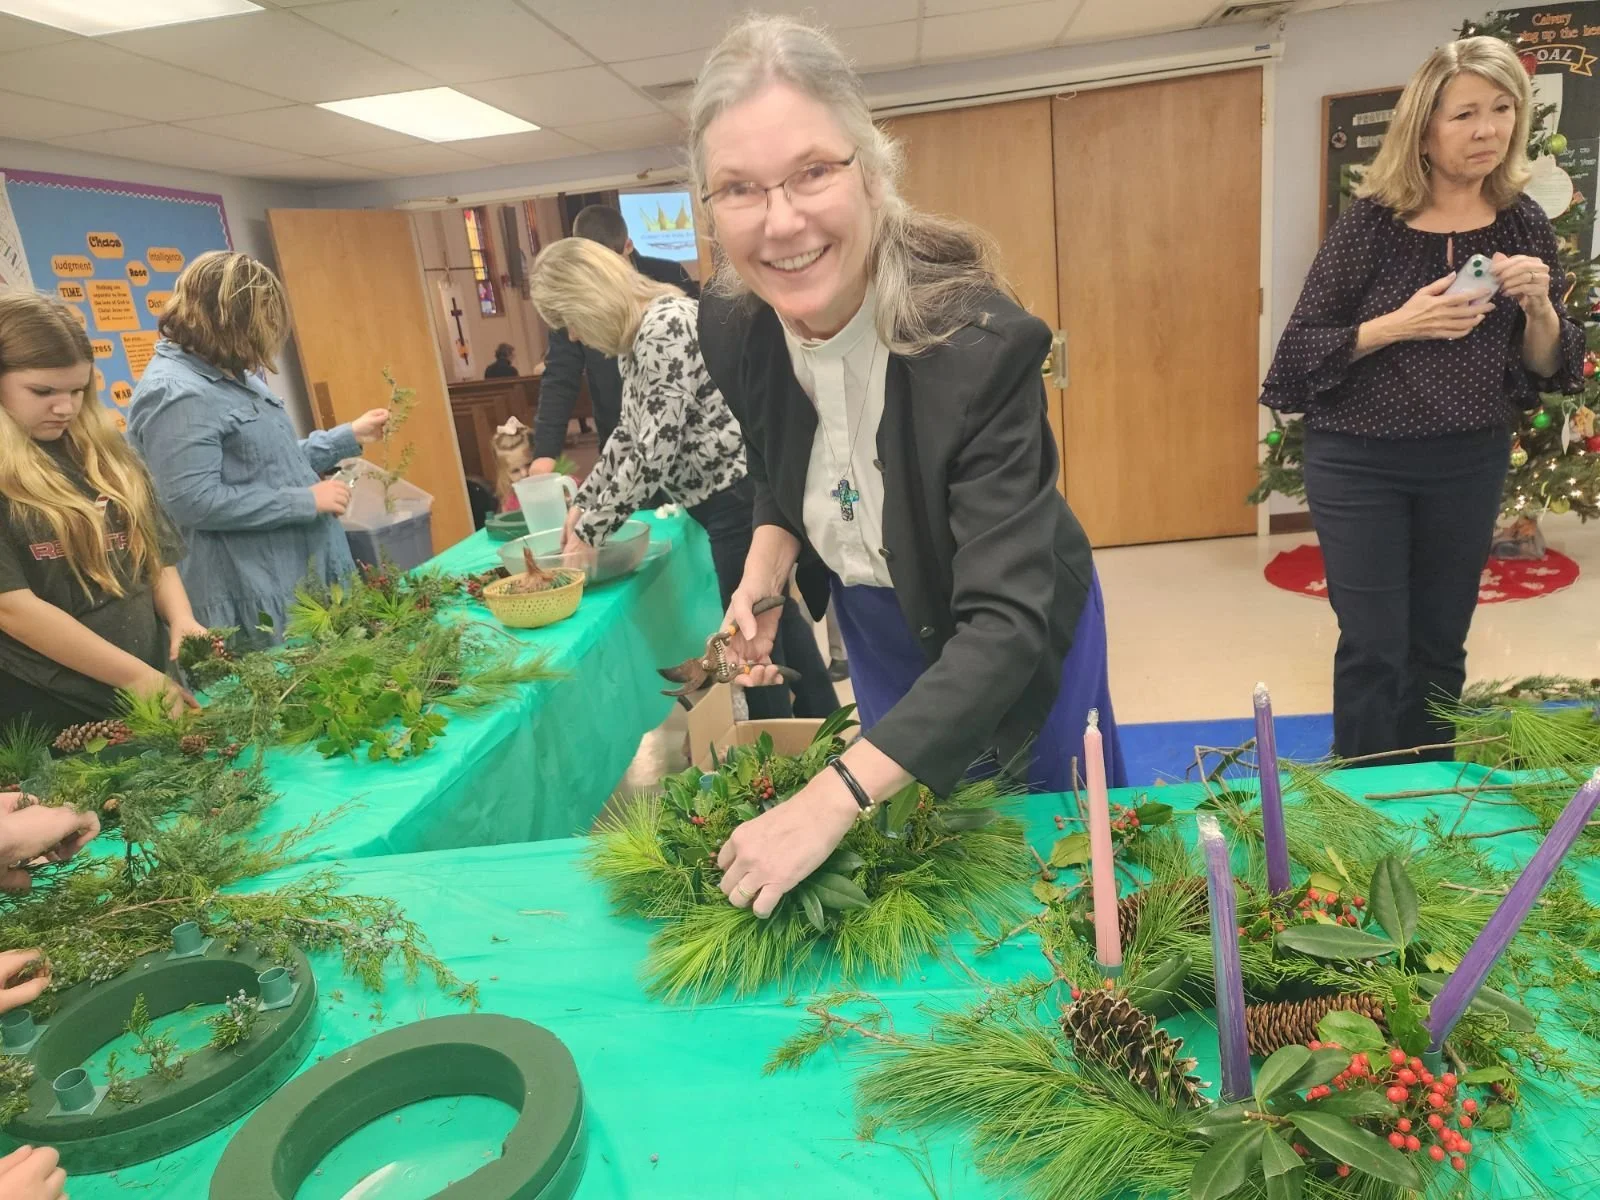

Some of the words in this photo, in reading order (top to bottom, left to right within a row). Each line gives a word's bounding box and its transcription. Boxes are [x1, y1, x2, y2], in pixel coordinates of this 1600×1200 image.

[1541, 30, 1556, 43] up
[1560, 26, 1579, 38] the
[1532, 48, 1573, 61] OAL
[88, 235, 122, 248] Chaos
[55, 260, 92, 273] Judgment
[60, 287, 82, 297] TIME
[148, 299, 164, 309] Dist
